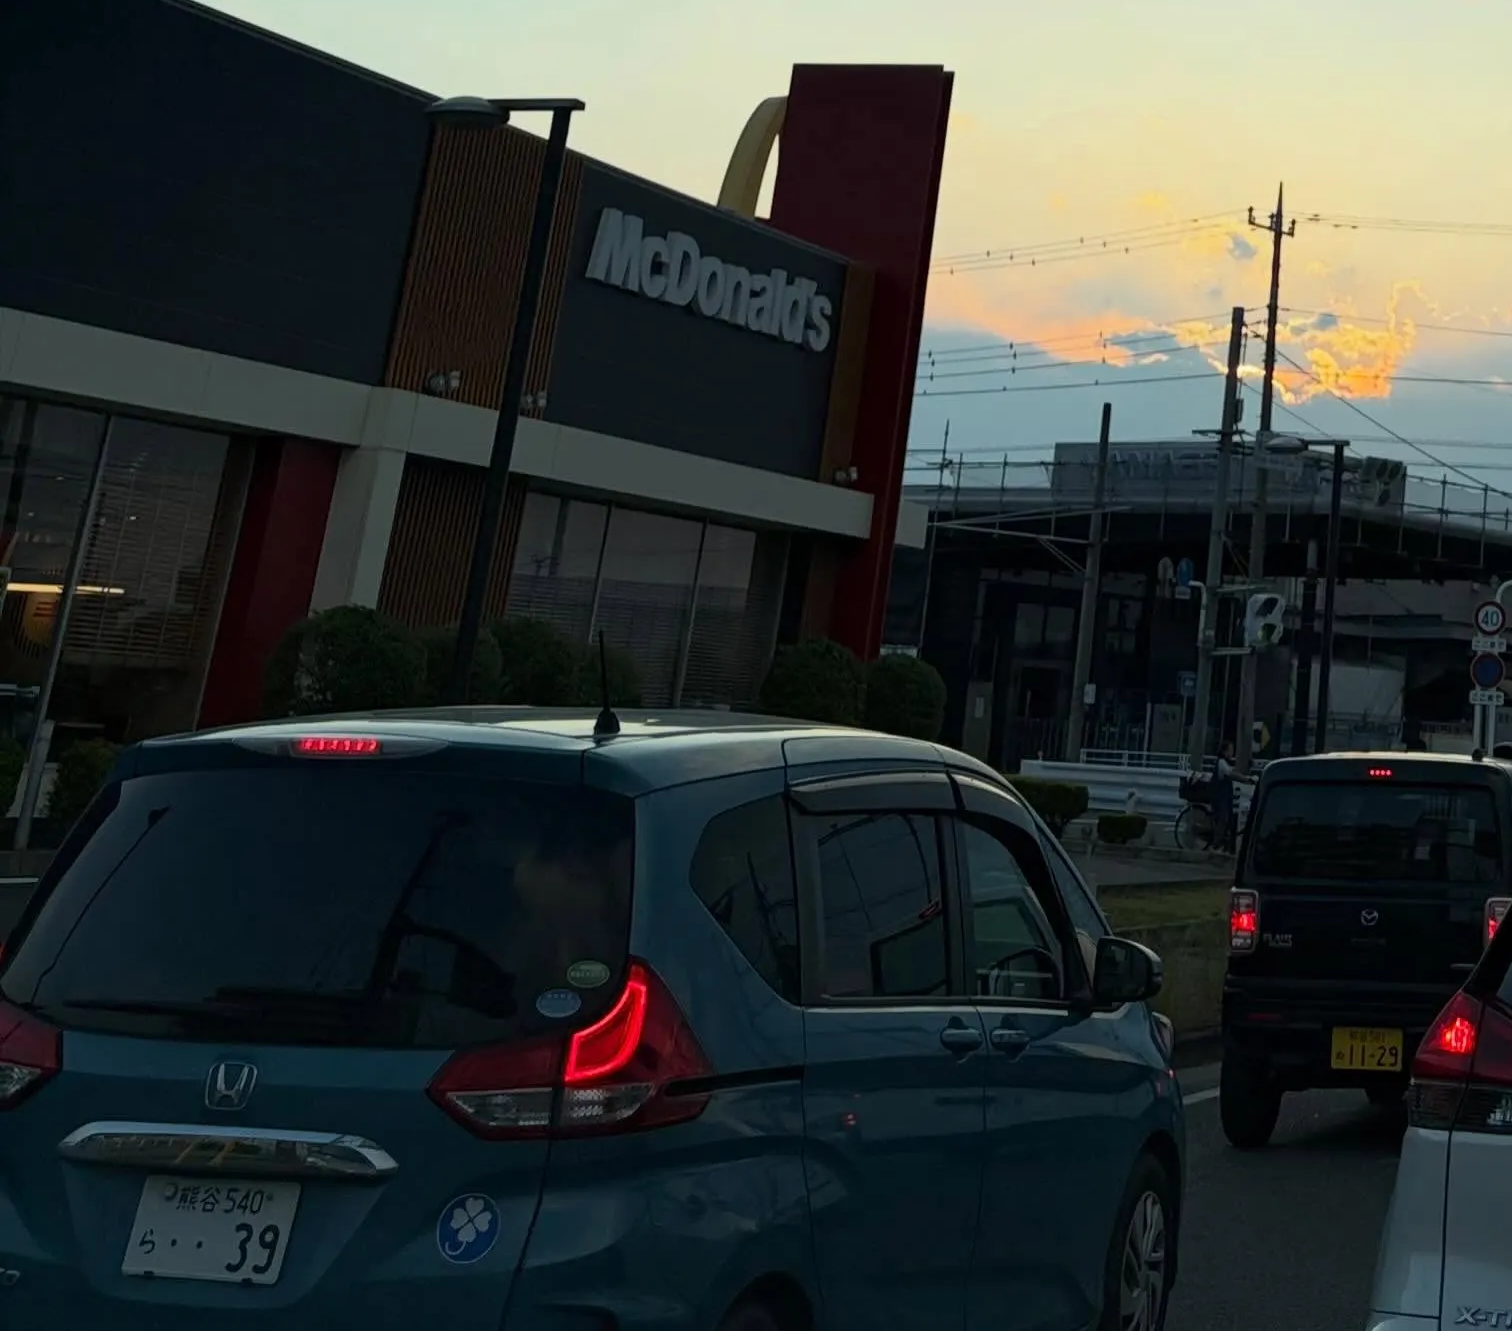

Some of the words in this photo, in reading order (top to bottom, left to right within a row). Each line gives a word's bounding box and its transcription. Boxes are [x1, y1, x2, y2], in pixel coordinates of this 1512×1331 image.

[585, 207, 832, 352] McDonald's
[1481, 610, 1500, 627] 40
[1349, 1044, 1398, 1067] 11-29
[139, 1228, 156, 1254] ら
